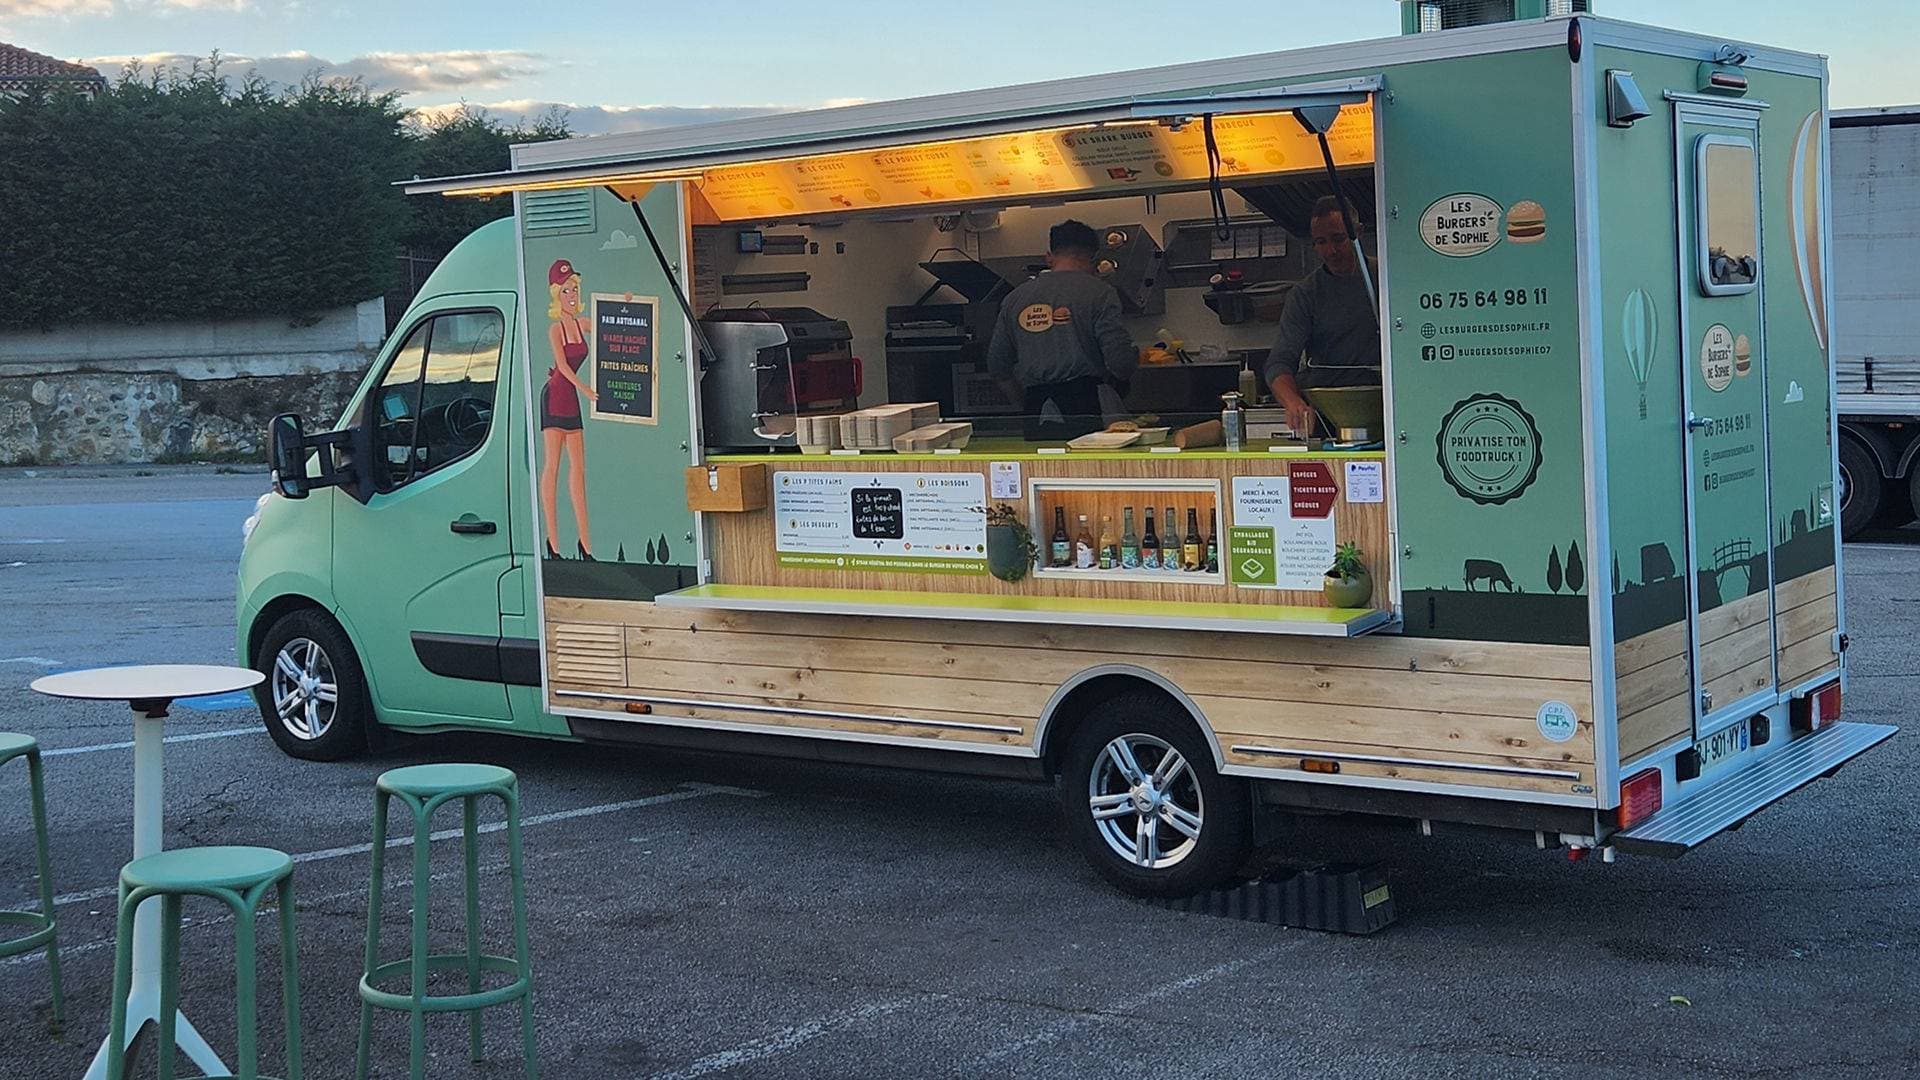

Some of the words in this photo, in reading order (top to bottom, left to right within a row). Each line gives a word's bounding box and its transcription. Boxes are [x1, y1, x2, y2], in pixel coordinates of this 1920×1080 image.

[1090, 134, 1117, 144] SHARK
[1119, 130, 1154, 141] BURGER
[1450, 201, 1471, 213] LES
[1437, 217, 1486, 230] BURGERS
[1452, 231, 1489, 244] SOPHIE
[1419, 293, 1443, 309] 06
[1448, 292, 1468, 308] 75
[1474, 290, 1498, 307] 64
[1504, 289, 1527, 306] 98
[1534, 288, 1547, 305] 11
[601, 315, 615, 324] PAIN
[616, 316, 648, 327] ARTISANAL
[1439, 322, 1551, 335] LESBURGERSDESOPHIE.FR
[1712, 332, 1723, 344] LES
[620, 345, 640, 354] PLACE
[1458, 345, 1552, 357] BURGERSDESOPHIE07
[600, 361, 620, 371] FRITES
[607, 380, 642, 392] GARNITURES
[613, 391, 636, 400] MAISON
[1715, 418, 1724, 435] 75
[1724, 417, 1734, 433] 64
[1735, 414, 1745, 431] 98
[1745, 413, 1752, 429] 11
[1451, 436, 1504, 447] PRIVATISE
[1506, 436, 1527, 447] TON
[1456, 451, 1515, 462] FOODTRUCK
[1293, 486, 1317, 494] TICKETS
[1240, 497, 1283, 505] FOURNISSEURS
[1233, 531, 1270, 539] EMBALLAGES
